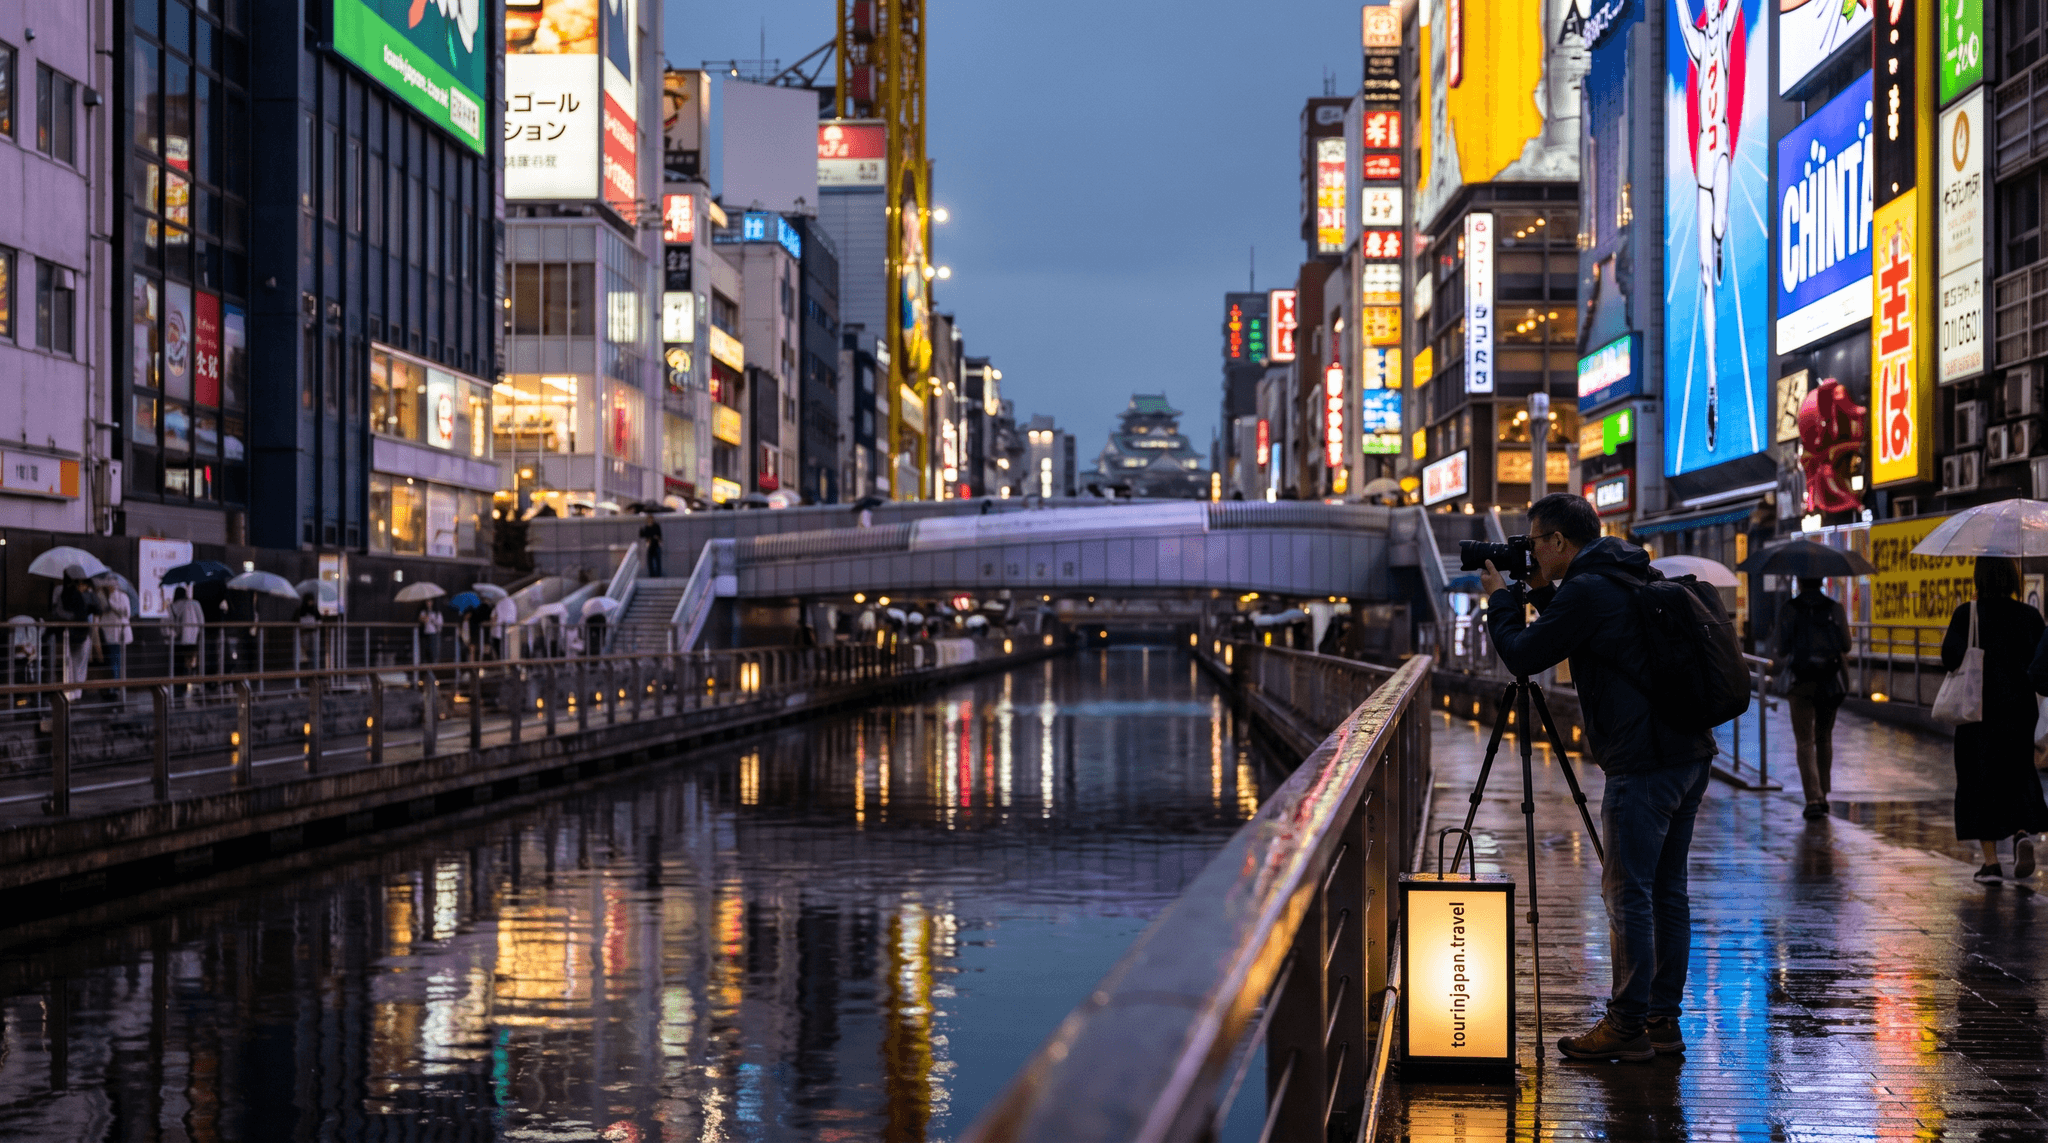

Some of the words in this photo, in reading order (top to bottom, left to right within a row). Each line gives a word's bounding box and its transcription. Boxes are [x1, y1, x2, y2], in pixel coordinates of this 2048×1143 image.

[1708, 59, 1718, 152] グリコ
[1449, 902, 1470, 1048] tourinjapan.travel
